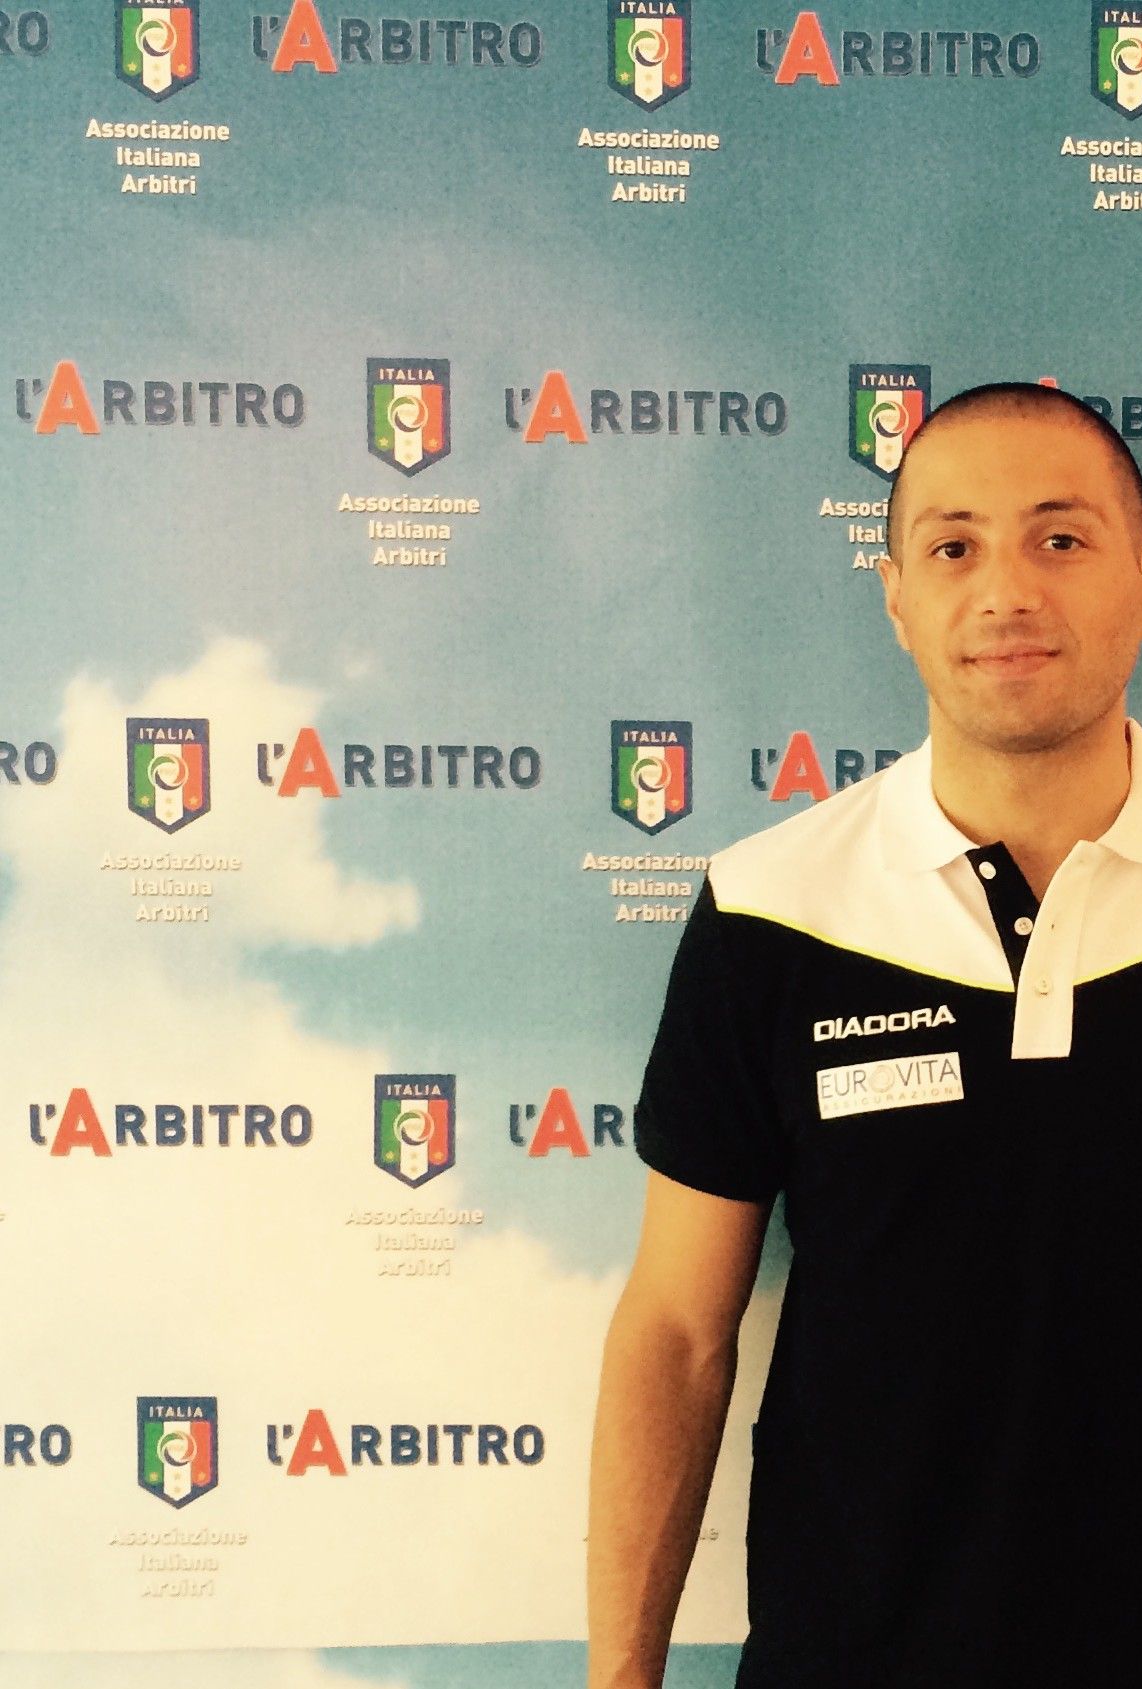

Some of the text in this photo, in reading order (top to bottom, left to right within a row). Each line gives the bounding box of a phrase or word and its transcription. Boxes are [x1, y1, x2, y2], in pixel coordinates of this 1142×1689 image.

[620, 2, 676, 16] ITALIA
[86, 119, 230, 141] Associazione
[577, 128, 719, 151] Associazione
[116, 147, 201, 168] Italiana
[608, 156, 690, 177] Italiana
[121, 174, 196, 195] Arbitri
[612, 183, 686, 203] Arbitri
[379, 368, 435, 382] ITALIA
[861, 374, 916, 388] ITALIA
[338, 493, 481, 515] Associazione
[368, 520, 451, 541] Italiana
[373, 547, 447, 567] Arbitri
[139, 728, 195, 741] ITALIA
[623, 731, 678, 743] ITALIA
[100, 851, 242, 872] Associazione
[582, 852, 711, 872] Associazion
[131, 878, 213, 898] Italiana
[611, 878, 692, 898] Italiana
[136, 903, 209, 922] Arbitri
[615, 904, 688, 923] Arbitri
[813, 1005, 956, 1042] DIADORA
[387, 1083, 442, 1097] ITALIA
[149, 1406, 203, 1418] ITALIA
